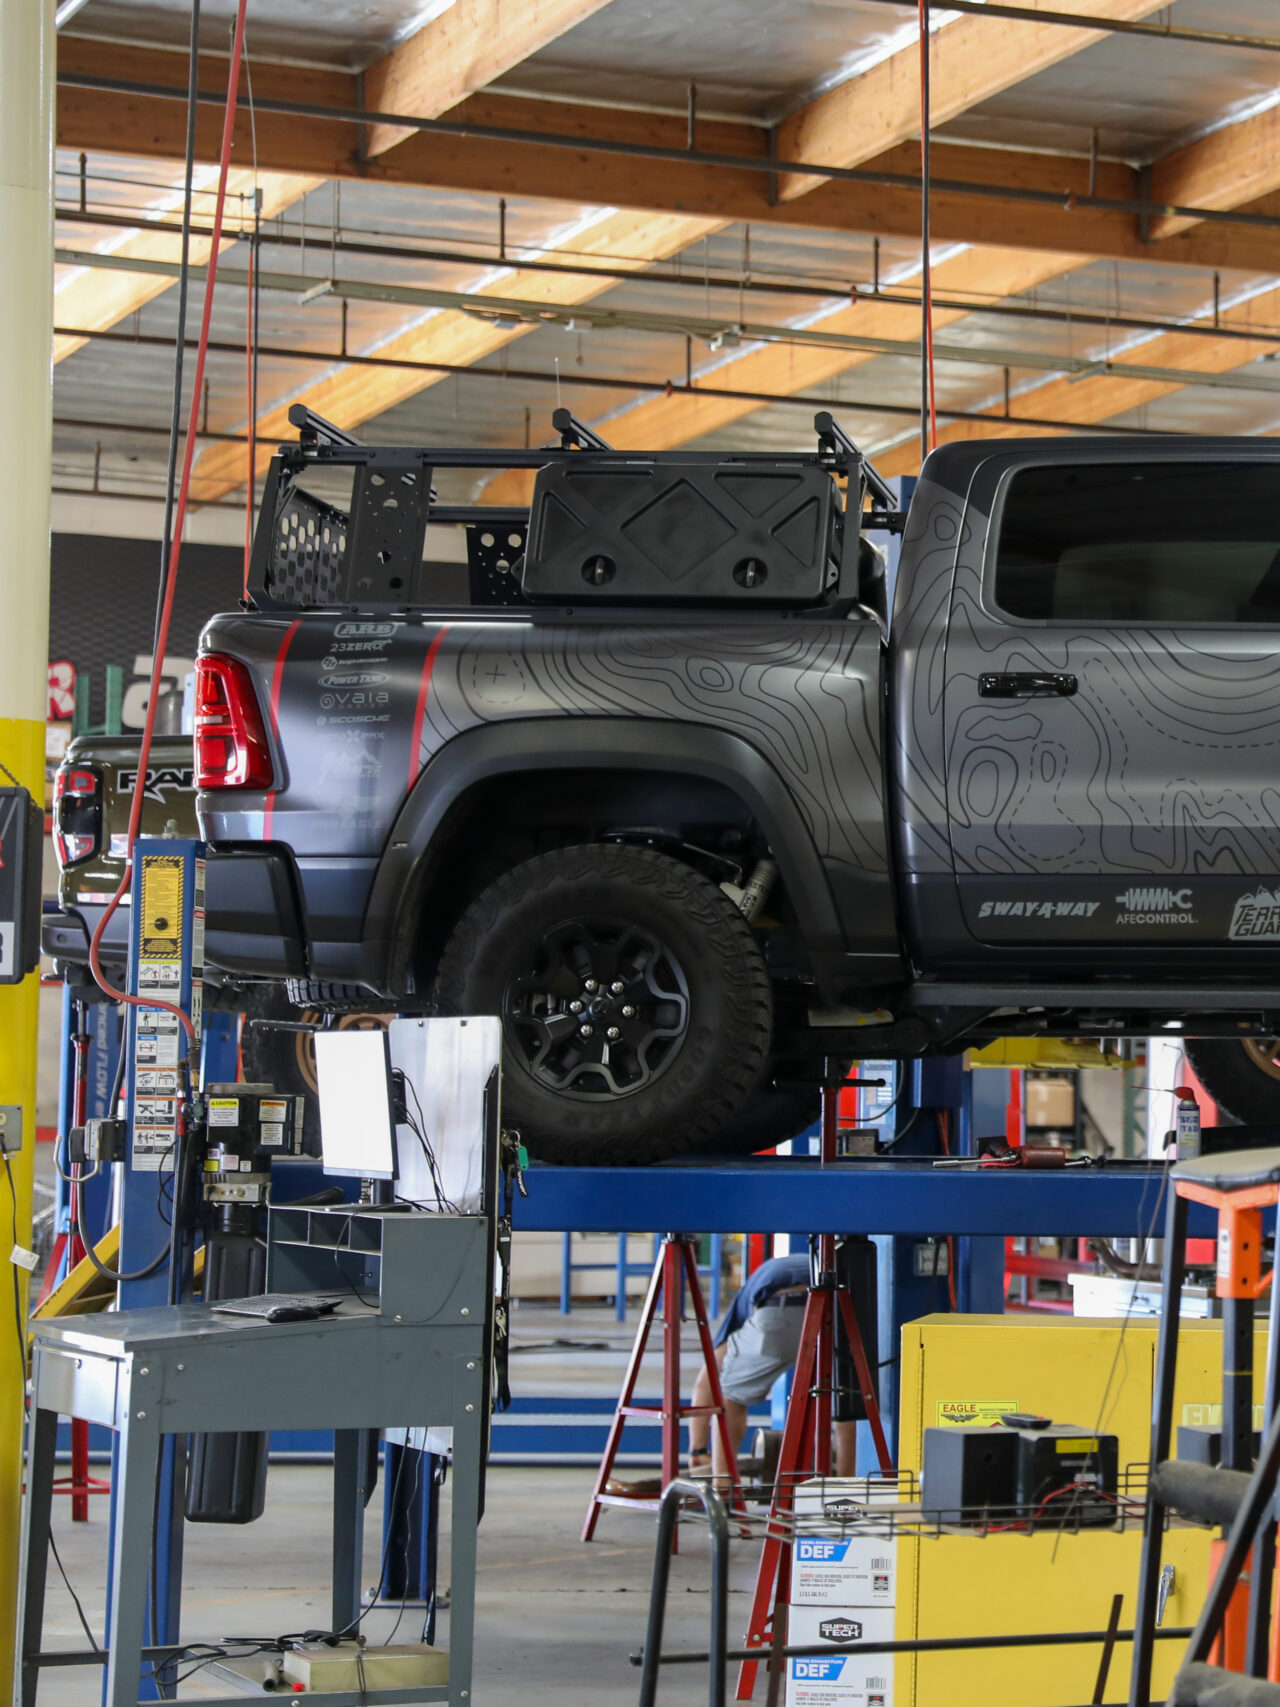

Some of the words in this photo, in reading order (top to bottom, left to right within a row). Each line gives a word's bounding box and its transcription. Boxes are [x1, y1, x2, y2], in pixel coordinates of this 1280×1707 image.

[340, 624, 392, 635] ARB
[330, 640, 385, 652] 23ZERO
[978, 901, 1101, 919] SWAY-A-WAY
[943, 1404, 977, 1412] EAGLE
[800, 1545, 834, 1559] DEF
[825, 1629, 859, 1637] TECH
[795, 1663, 830, 1678] DEF
